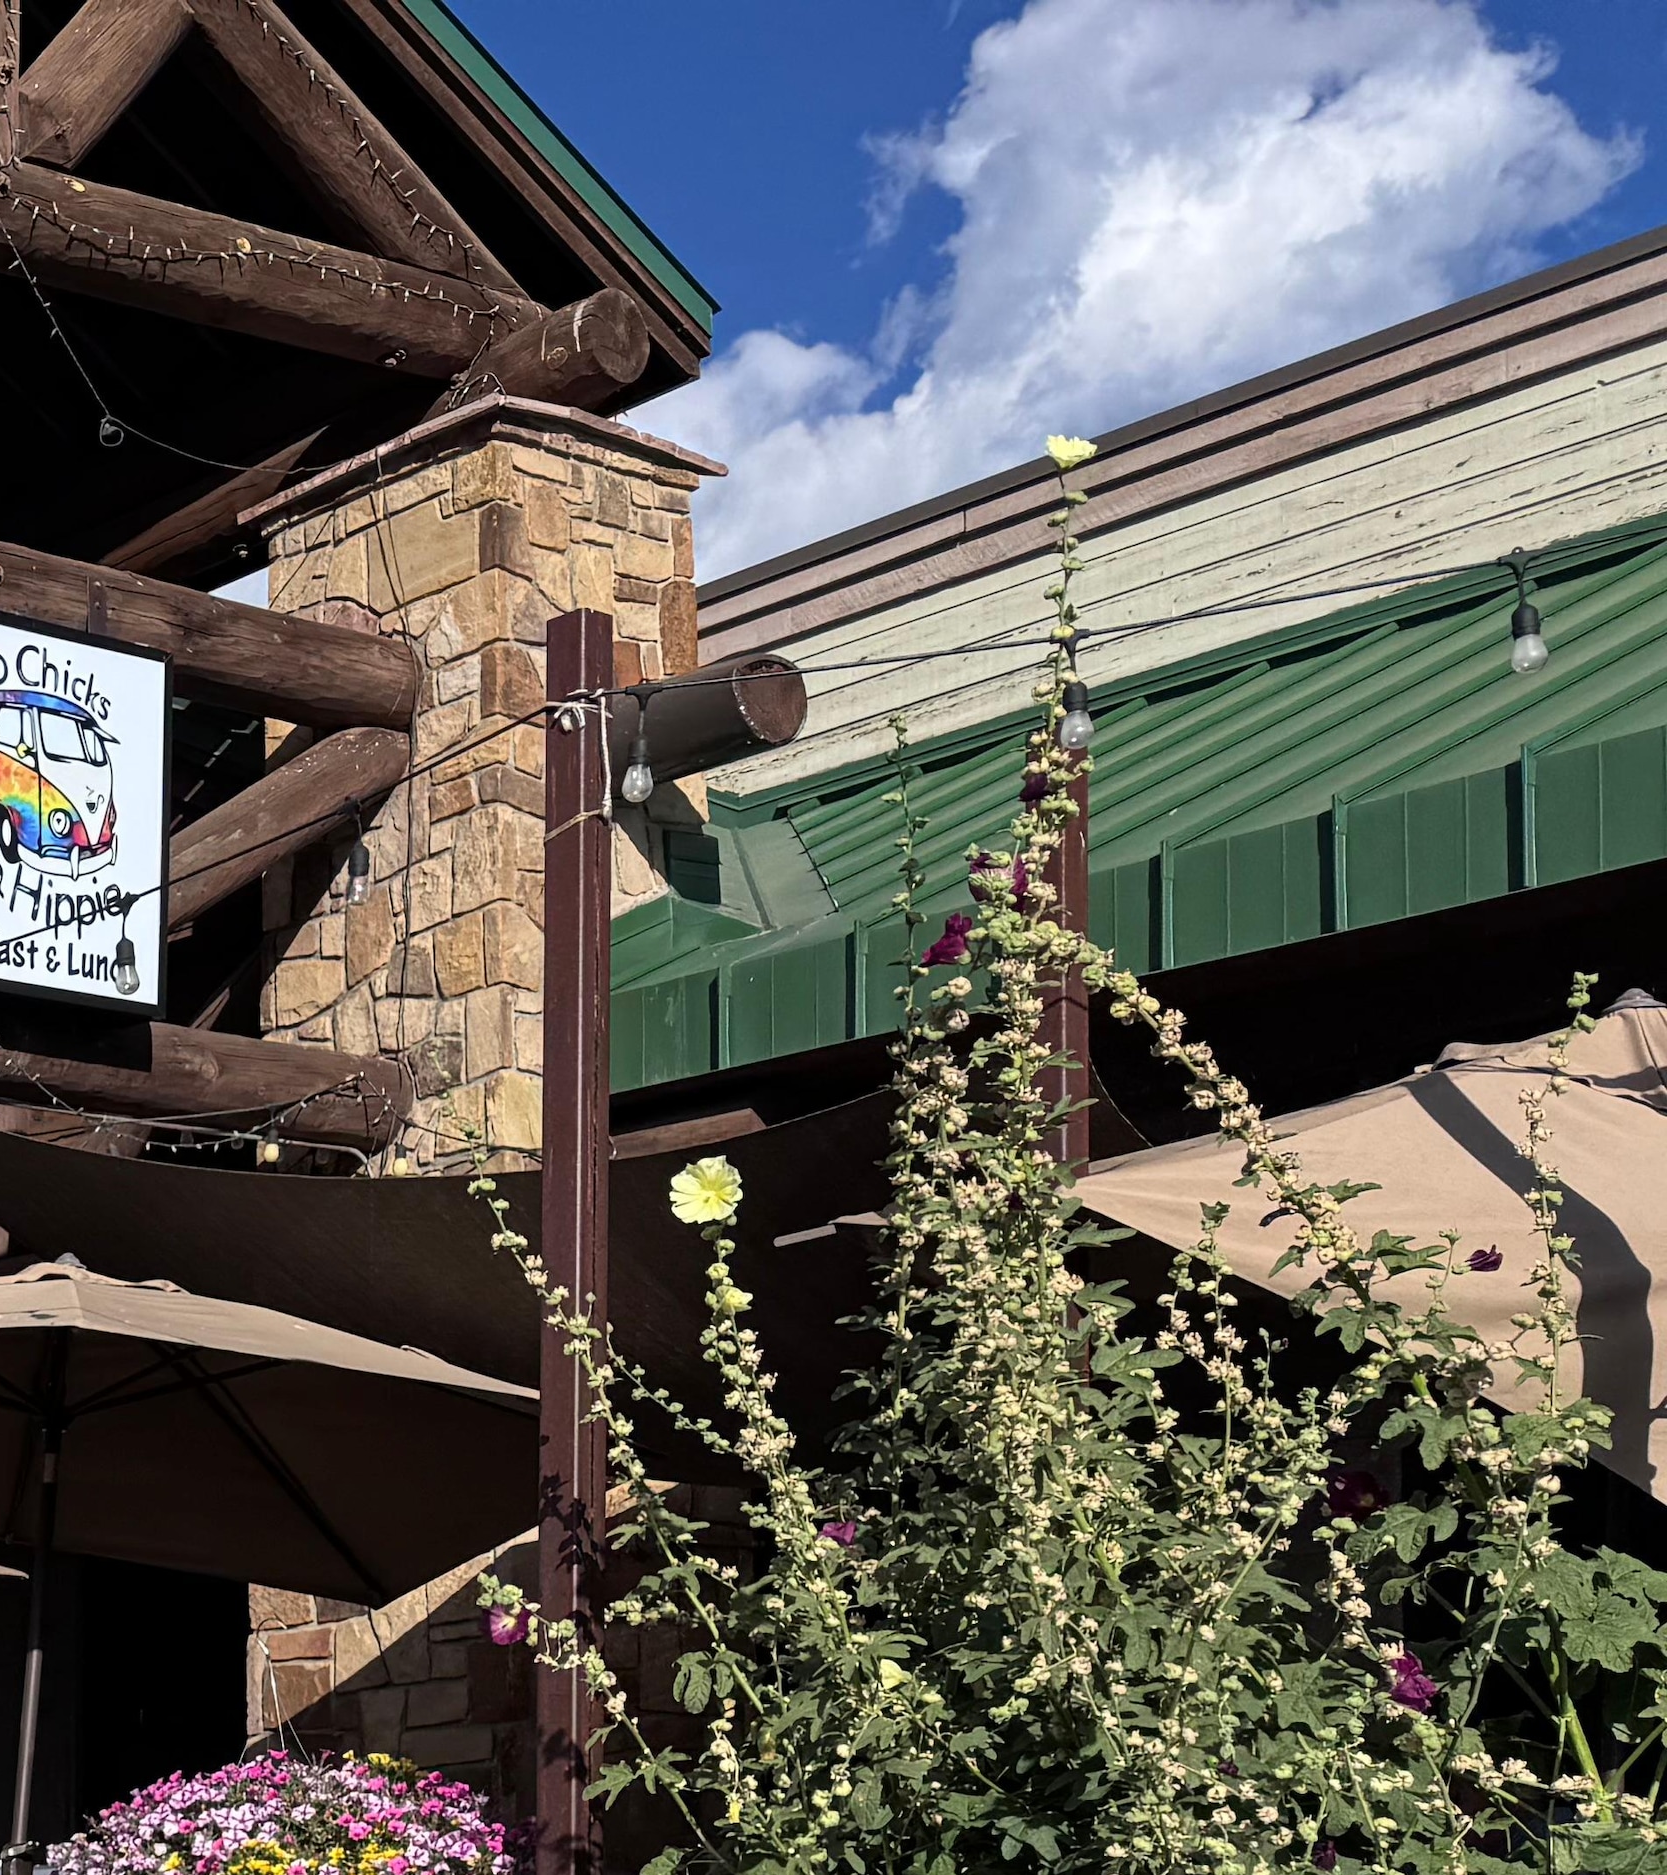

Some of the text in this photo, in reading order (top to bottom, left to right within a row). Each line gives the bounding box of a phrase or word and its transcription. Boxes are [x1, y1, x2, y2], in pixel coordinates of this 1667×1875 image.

[15, 644, 112, 721] Chicks
[9, 862, 123, 940] Hippie
[45, 946, 61, 973] &
[68, 942, 119, 984] Lun
